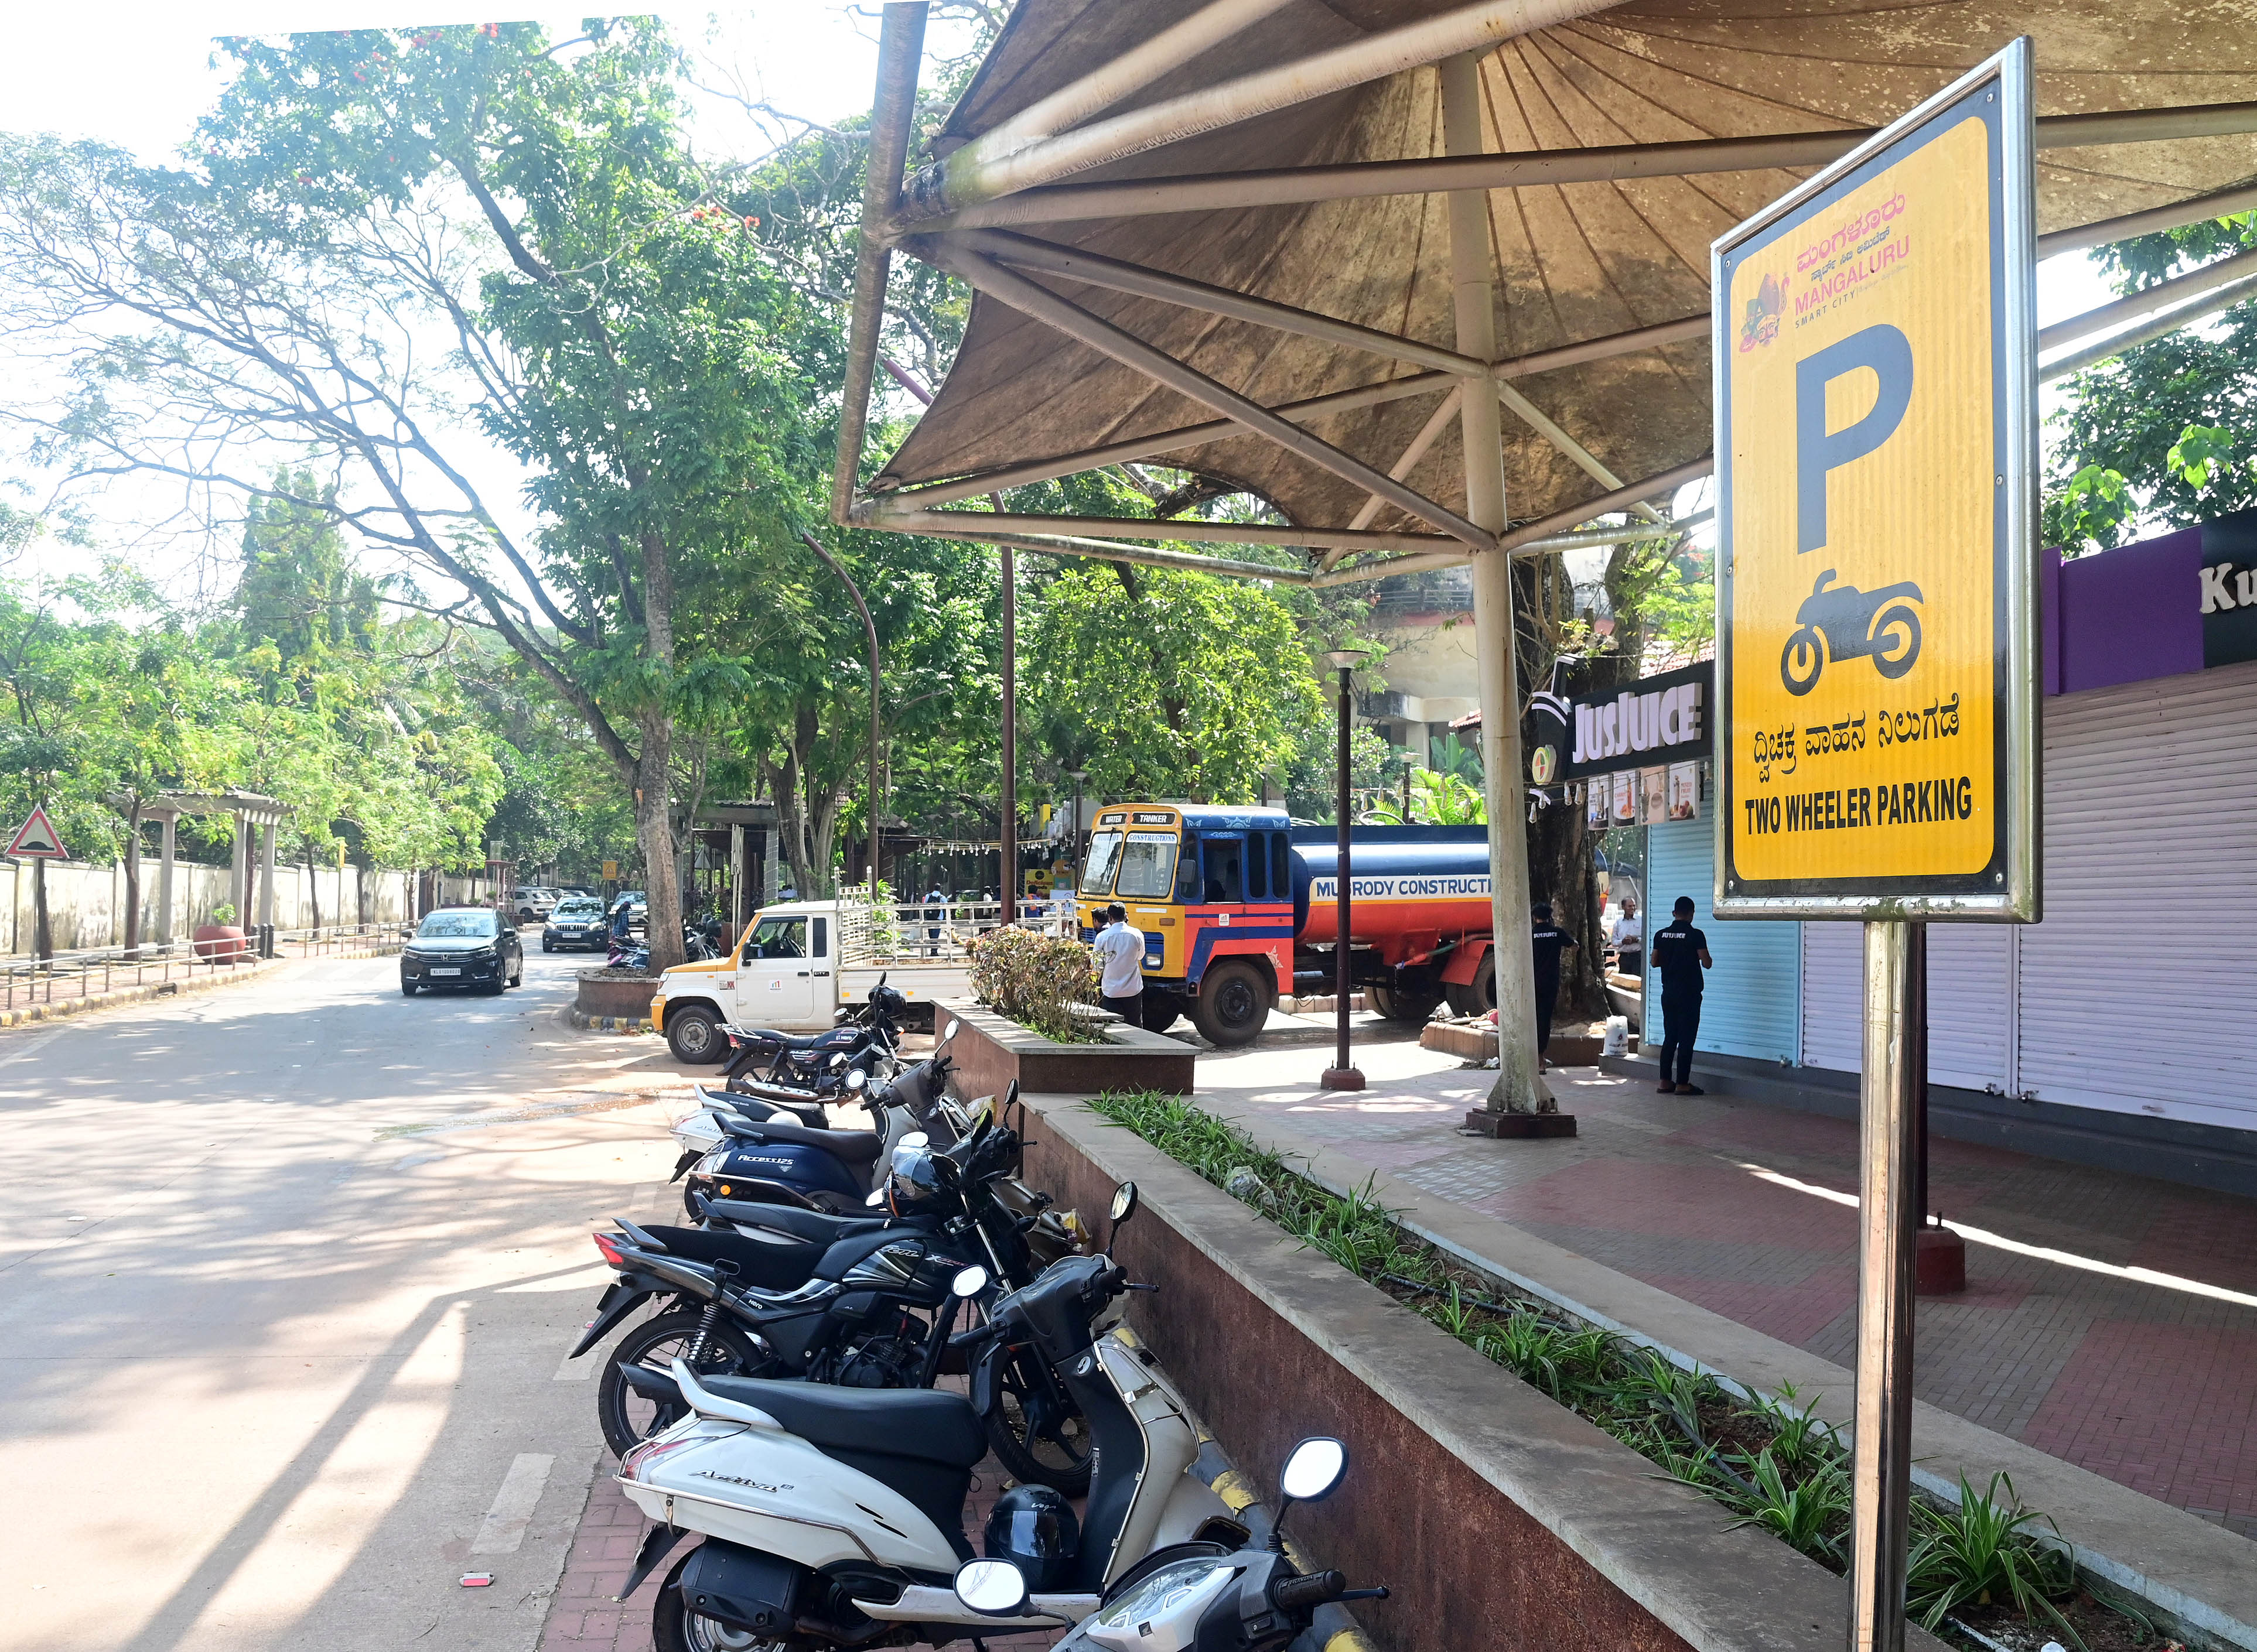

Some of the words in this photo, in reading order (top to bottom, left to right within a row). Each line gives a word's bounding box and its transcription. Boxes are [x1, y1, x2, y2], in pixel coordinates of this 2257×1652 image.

[1795, 234, 1910, 316] MANGALURU
[1795, 305, 1828, 329] SMART
[1832, 290, 1856, 309] CITY
[1796, 324, 1914, 555] P
[1805, 710, 1866, 756] ವಾಹನ
[1878, 692, 1959, 748] ನಿಲುಗಡೆ
[1105, 815, 1122, 823] WATER
[1139, 814, 1167, 823] TANKER
[1745, 796, 1781, 835] TWO
[1785, 787, 1872, 832] WHEELER
[1877, 776, 1972, 826] PARKING
[1129, 834, 1176, 842] CONSTRUCTIONS
[1316, 881, 1395, 897] MURODY
[1398, 878, 1491, 895] CONSTRUCTI
[748, 1298, 763, 1309] Hero
[688, 1469, 778, 1493] Activa
